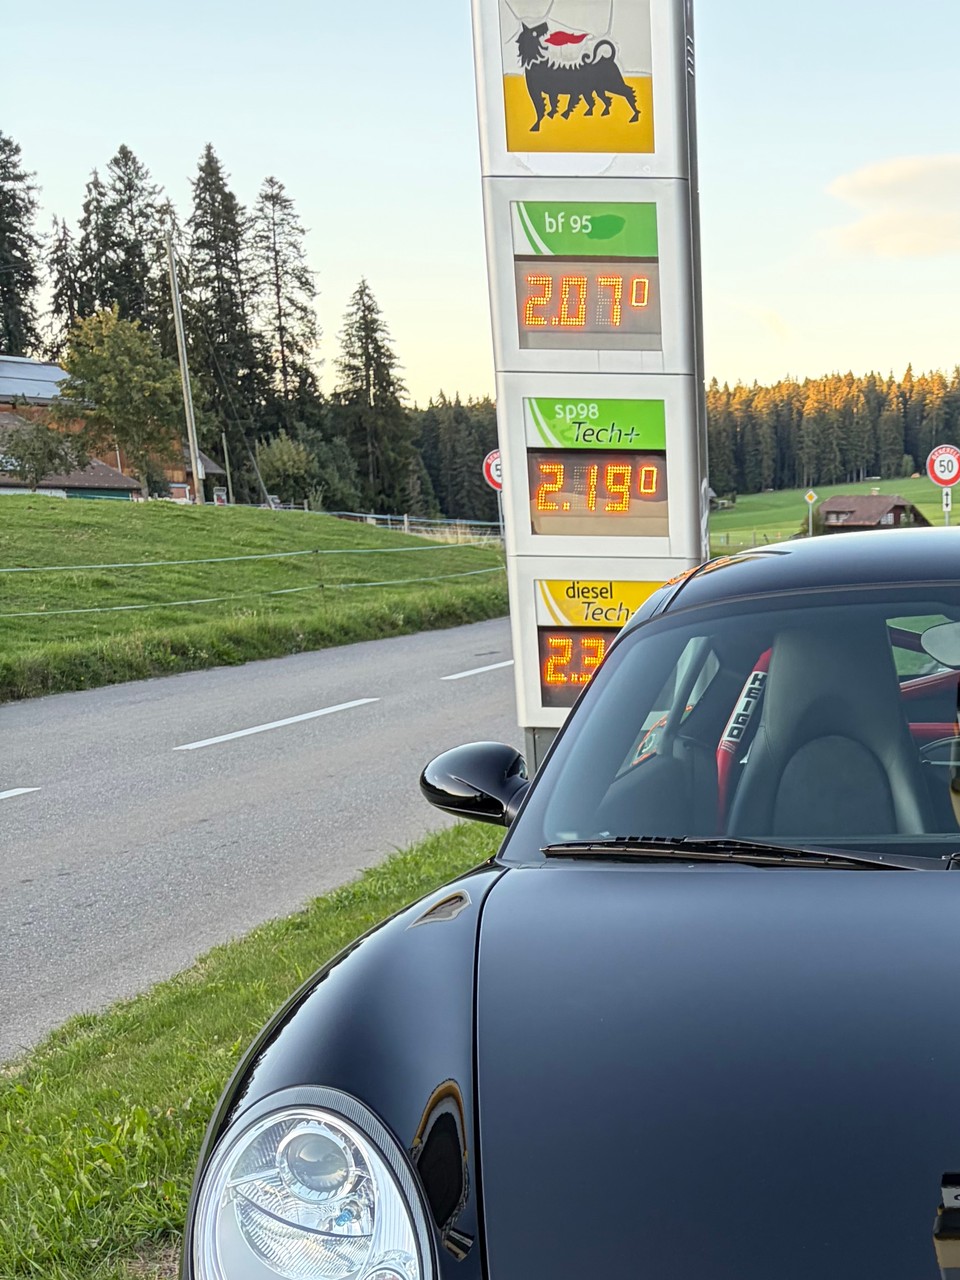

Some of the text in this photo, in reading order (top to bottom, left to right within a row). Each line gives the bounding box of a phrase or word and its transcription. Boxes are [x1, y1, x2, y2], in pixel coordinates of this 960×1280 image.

[544, 211, 592, 233] bf 95
[554, 403, 600, 423] sp98
[571, 421, 641, 443] Tech+
[939, 459, 953, 473] 50
[565, 581, 614, 600] diesel
[581, 601, 635, 622] Tech
[726, 673, 769, 740] HEIGO
